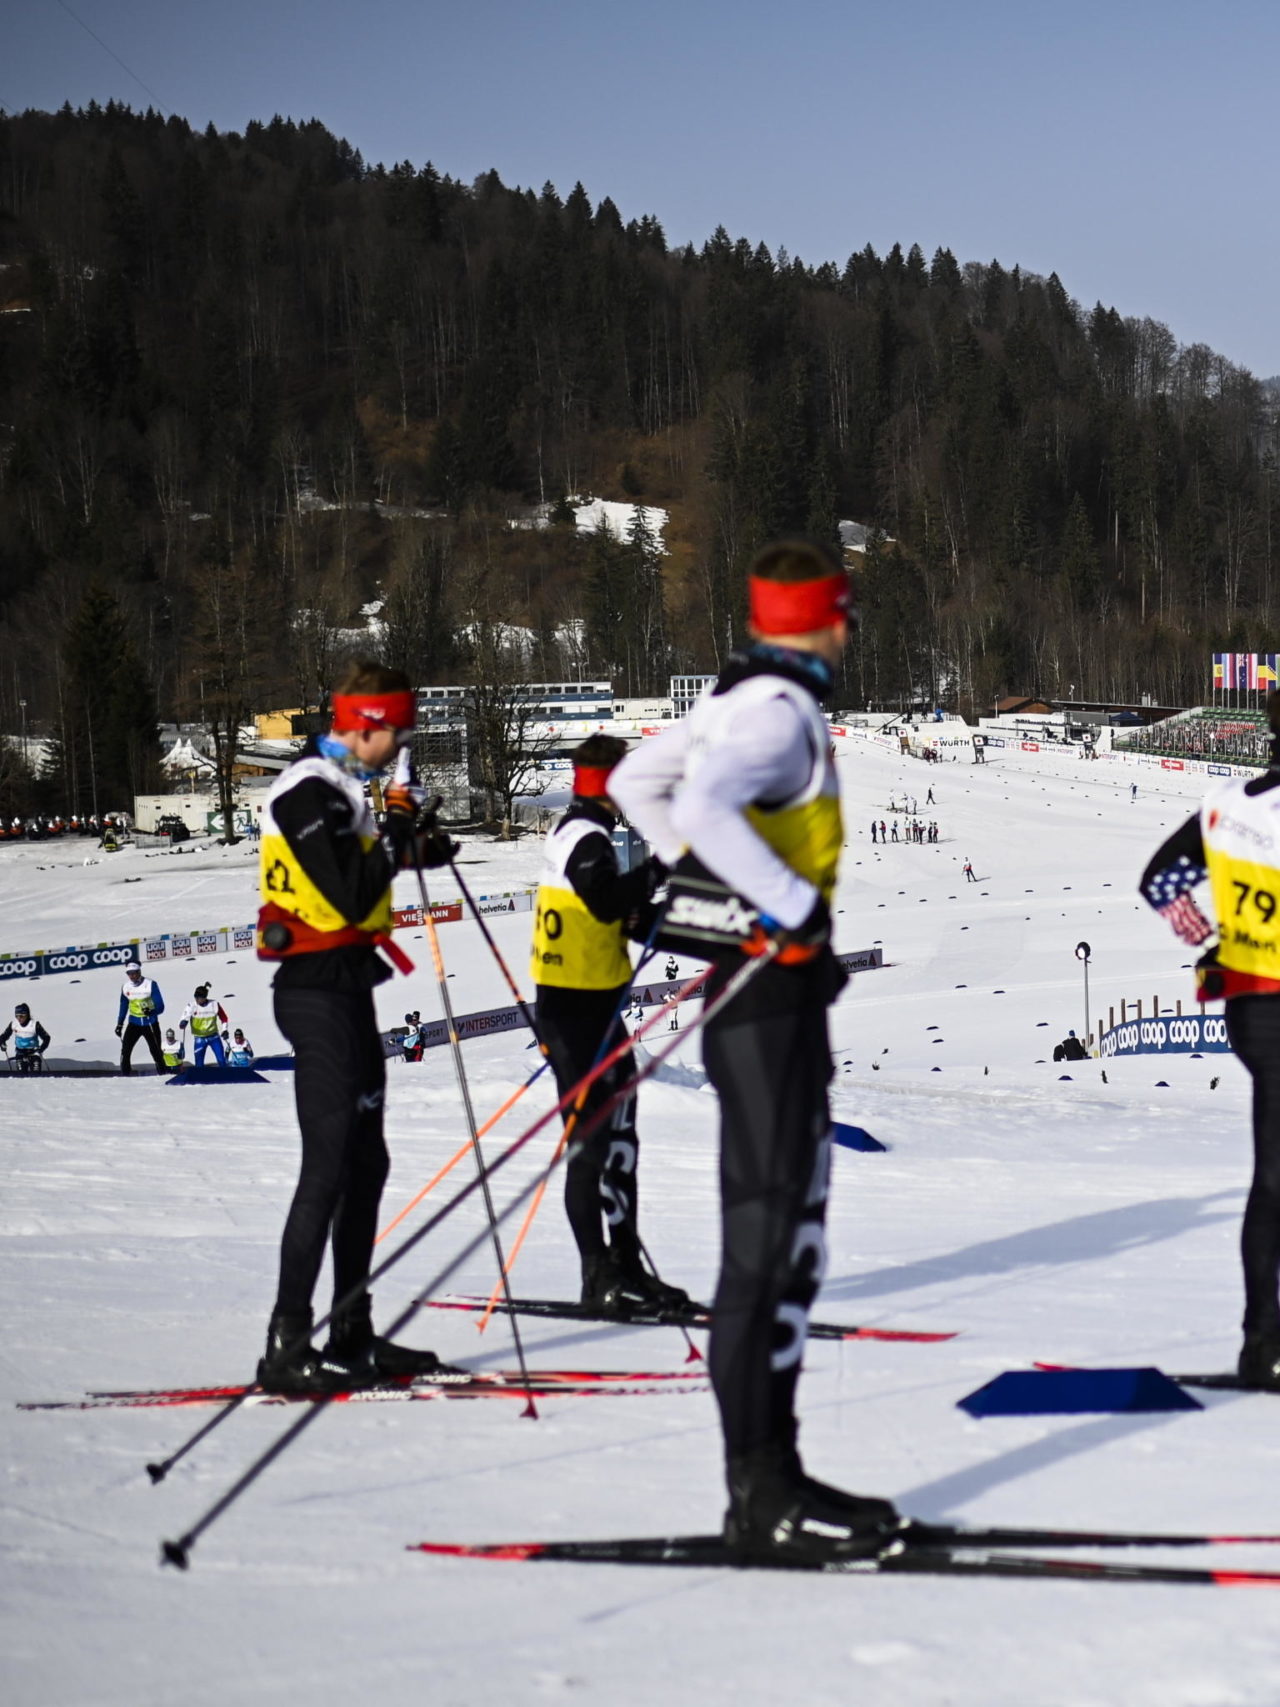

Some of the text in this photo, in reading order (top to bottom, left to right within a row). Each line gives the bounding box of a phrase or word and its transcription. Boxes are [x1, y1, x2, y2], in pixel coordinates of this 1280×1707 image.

[1232, 880, 1277, 923] 79
[401, 909, 449, 925] VIESSANN
[49, 948, 132, 969] coop coop
[465, 1011, 519, 1033] INTERSPORT
[1118, 1024, 1139, 1052] coop
[1141, 1021, 1166, 1050] coop
[1169, 1019, 1200, 1048] coop
[1203, 1019, 1231, 1049] coo
[349, 1390, 412, 1401] ATOMIC
